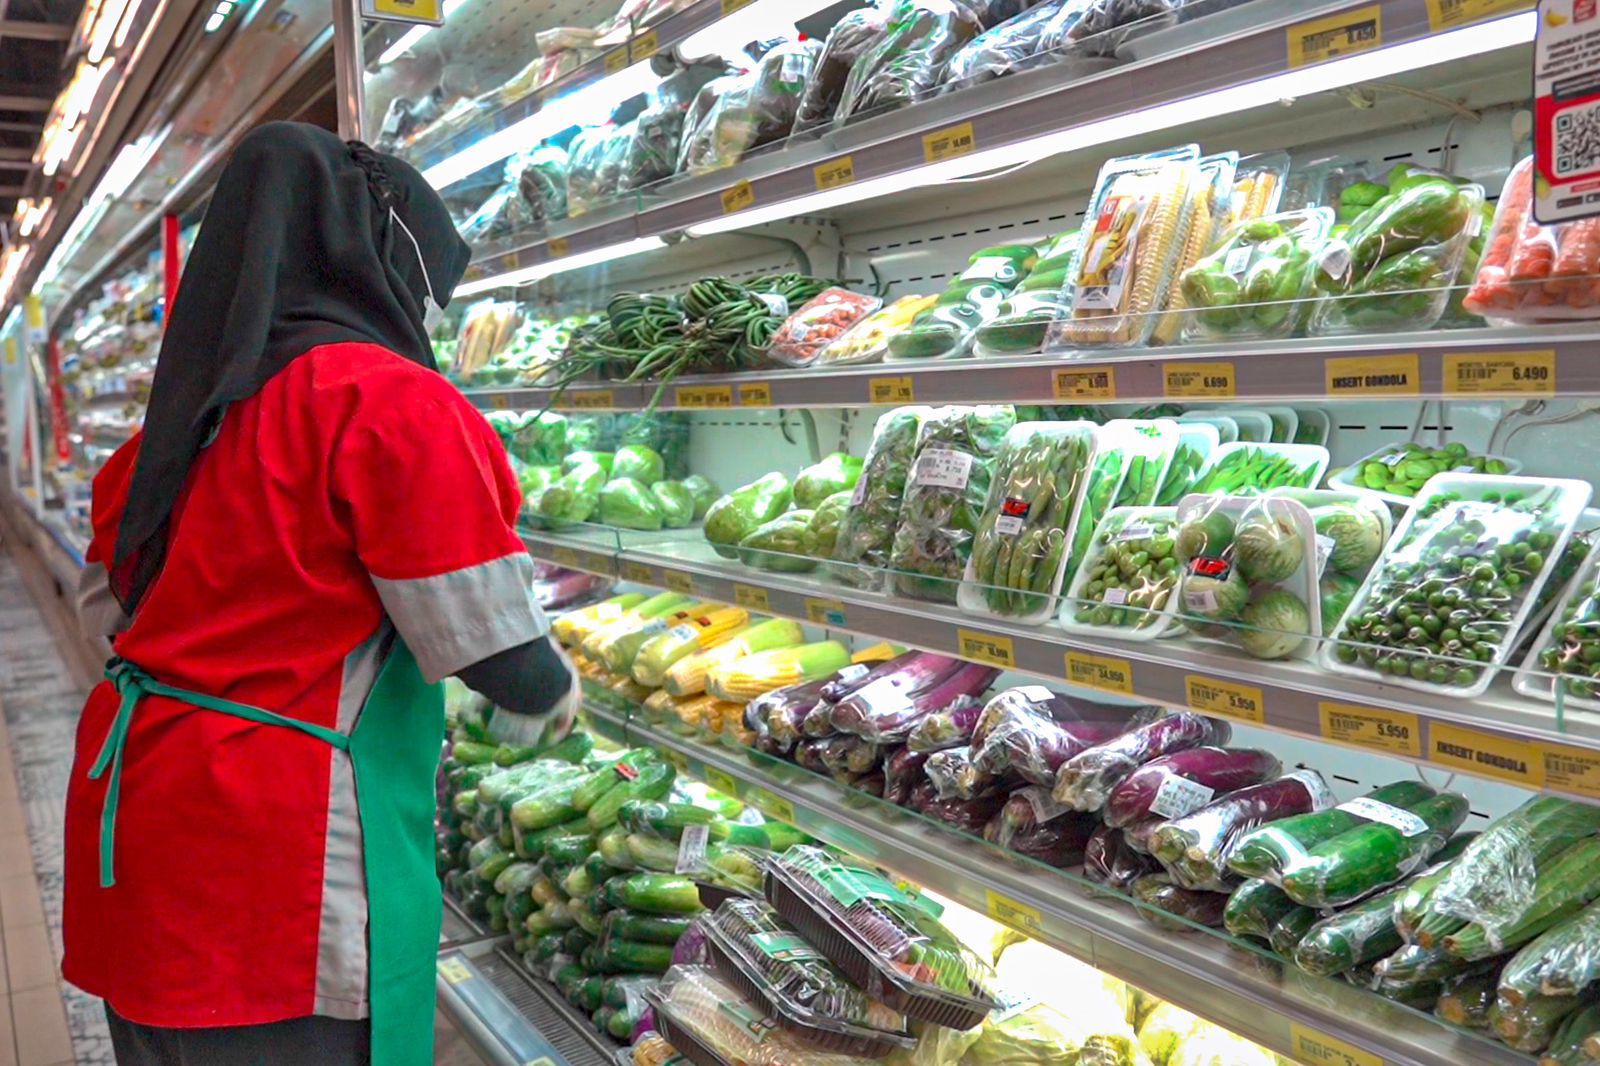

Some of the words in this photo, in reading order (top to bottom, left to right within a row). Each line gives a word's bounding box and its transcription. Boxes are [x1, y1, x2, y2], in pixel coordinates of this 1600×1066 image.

[1512, 366, 1548, 380] 6.490
[1332, 376, 1363, 388] INSERT
[1365, 374, 1408, 387] GONDOLA
[1377, 723, 1409, 740] 5.950
[1436, 741, 1474, 761] INSERT
[1476, 750, 1528, 774] GONDOLA
